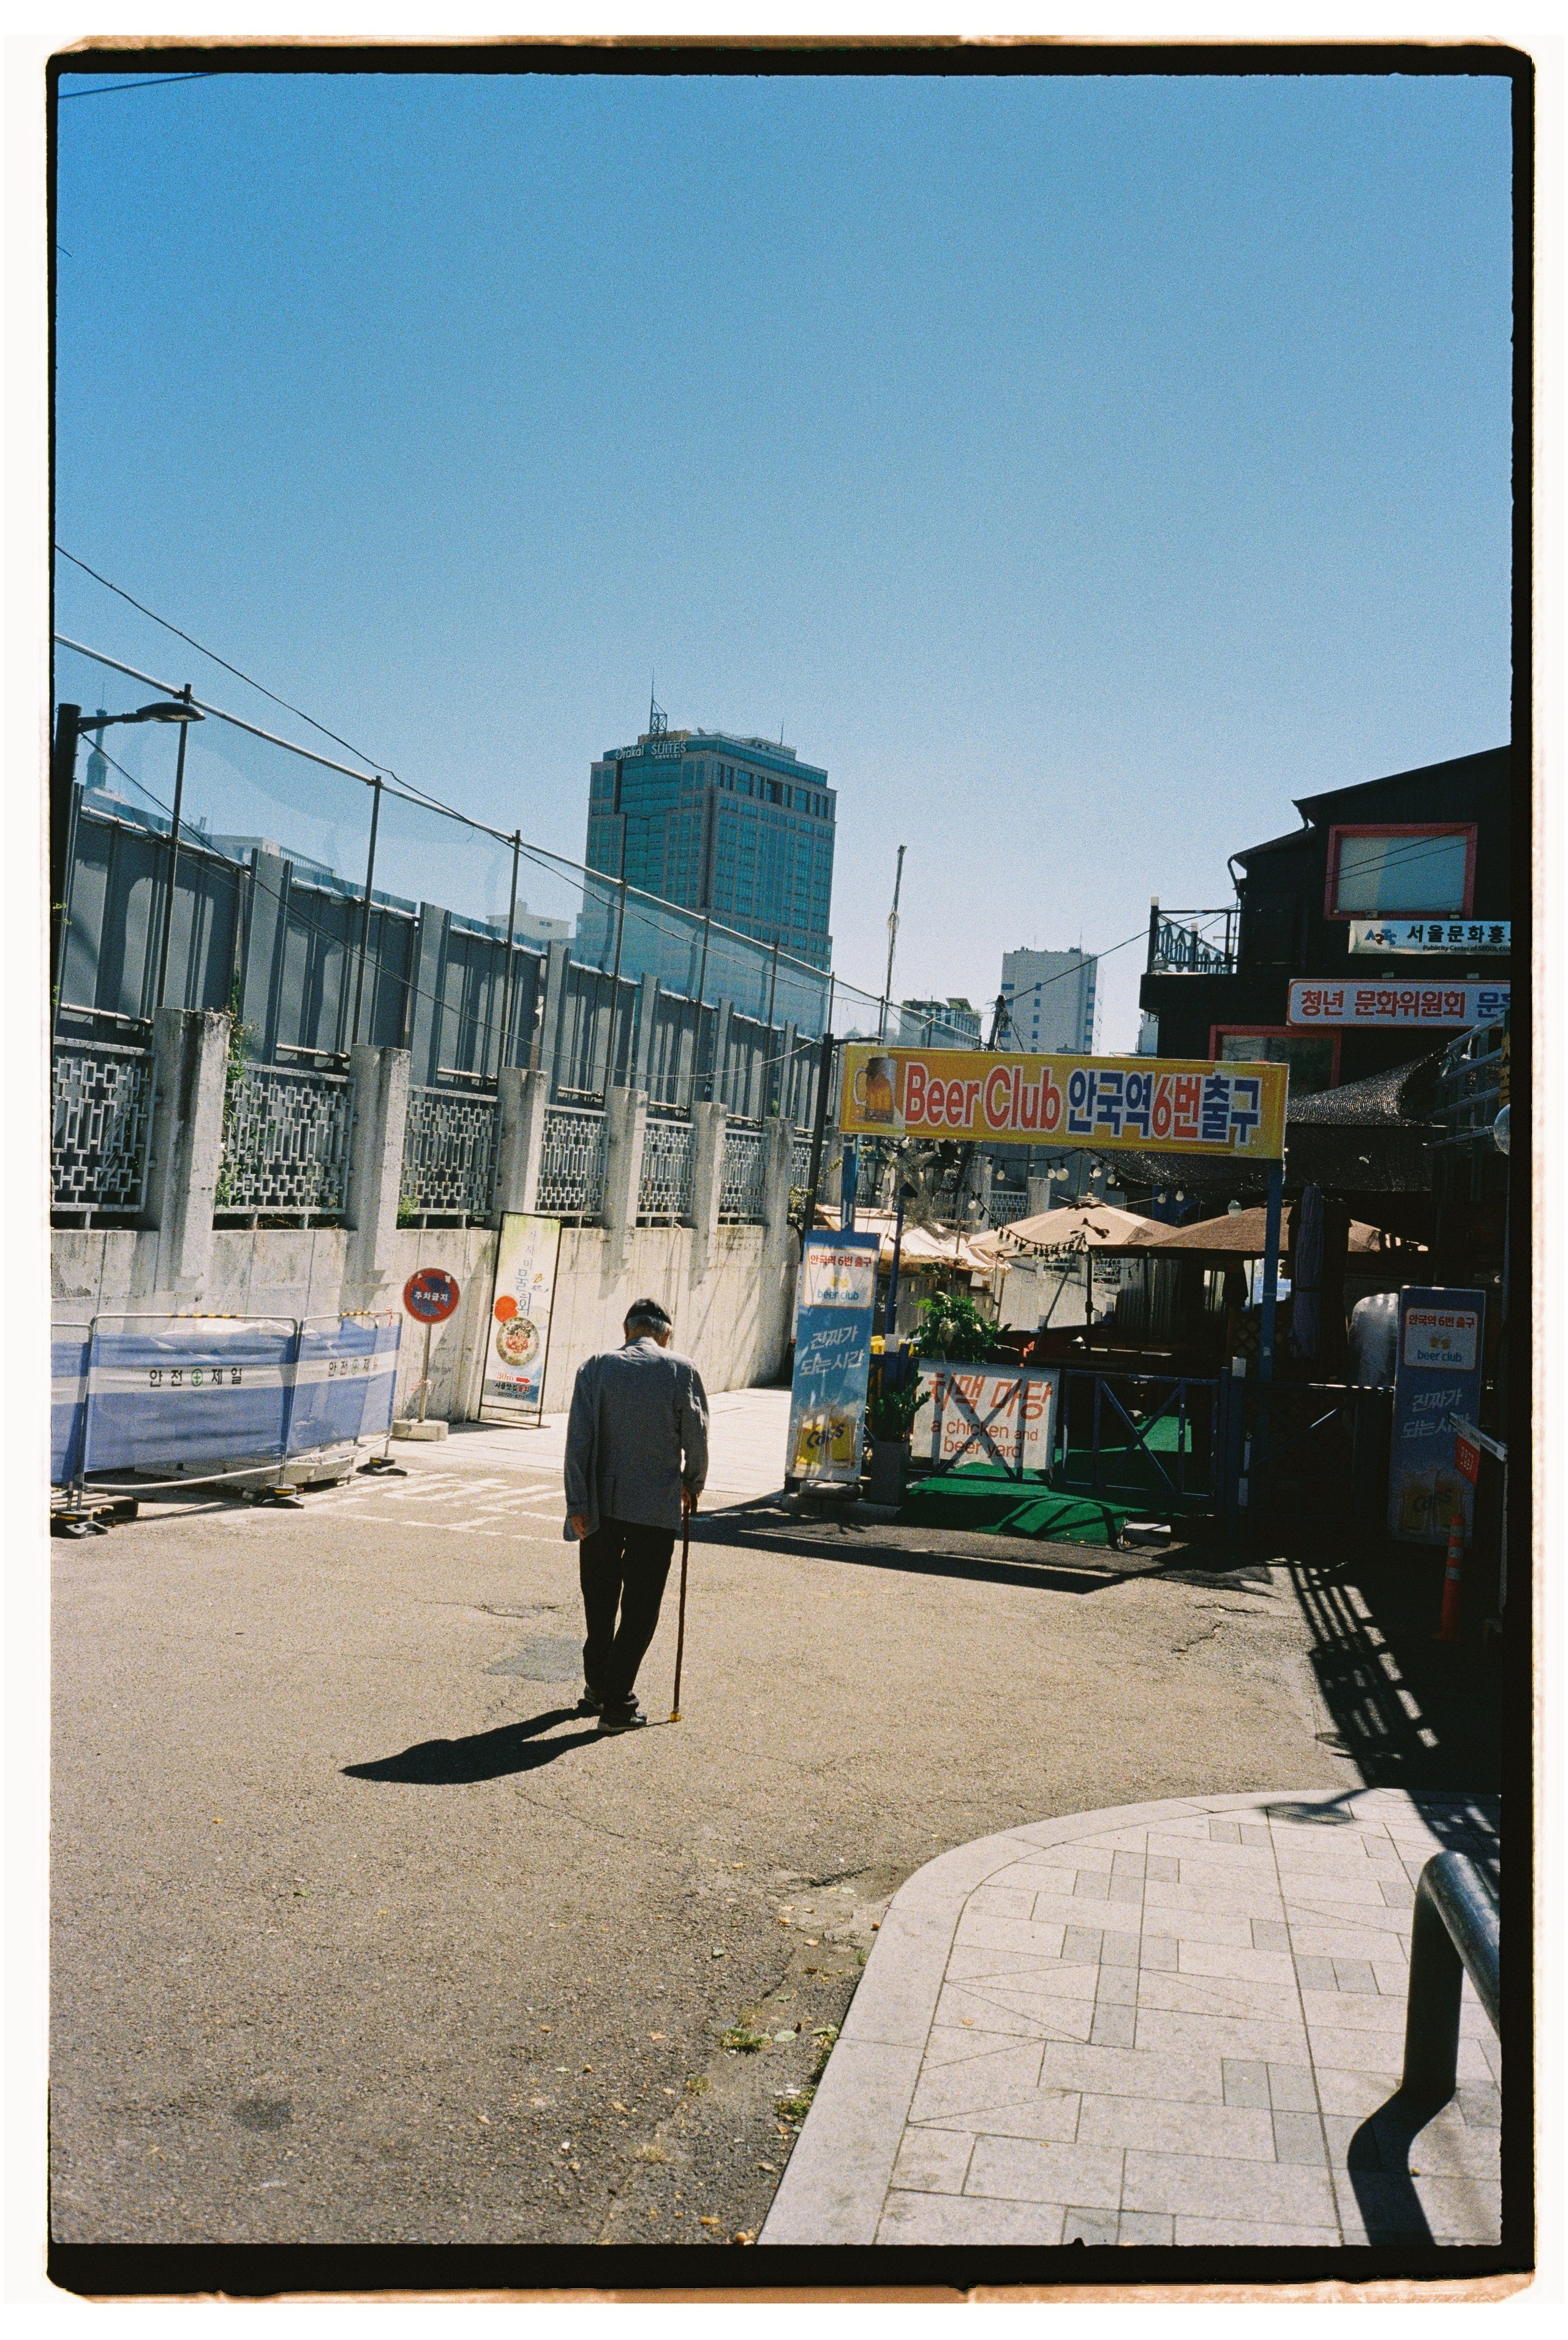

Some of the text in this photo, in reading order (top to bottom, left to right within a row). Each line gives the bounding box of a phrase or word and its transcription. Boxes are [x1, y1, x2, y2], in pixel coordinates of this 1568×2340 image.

[651, 742, 687, 755] SUITES
[1407, 924, 1511, 944] 서울문화홍
[1301, 990, 1344, 1017] 청년
[1354, 990, 1466, 1019] 문화위원회
[906, 1063, 979, 1127] Beer
[985, 1066, 1060, 1131] Club
[810, 1255, 872, 1268] 안국역 6번 출구
[415, 1291, 448, 1302] 주차금지
[817, 1289, 859, 1300] beer club
[1409, 1315, 1475, 1329] 안국역 6번 출구
[810, 1325, 859, 1349] 진짜가
[1417, 1349, 1462, 1362] beer club
[929, 1373, 1053, 1420] 치맥 마당
[1412, 1388, 1463, 1413] 진짜가
[930, 1418, 1038, 1441] a chicken and
[944, 1436, 1023, 1459] beer yard
